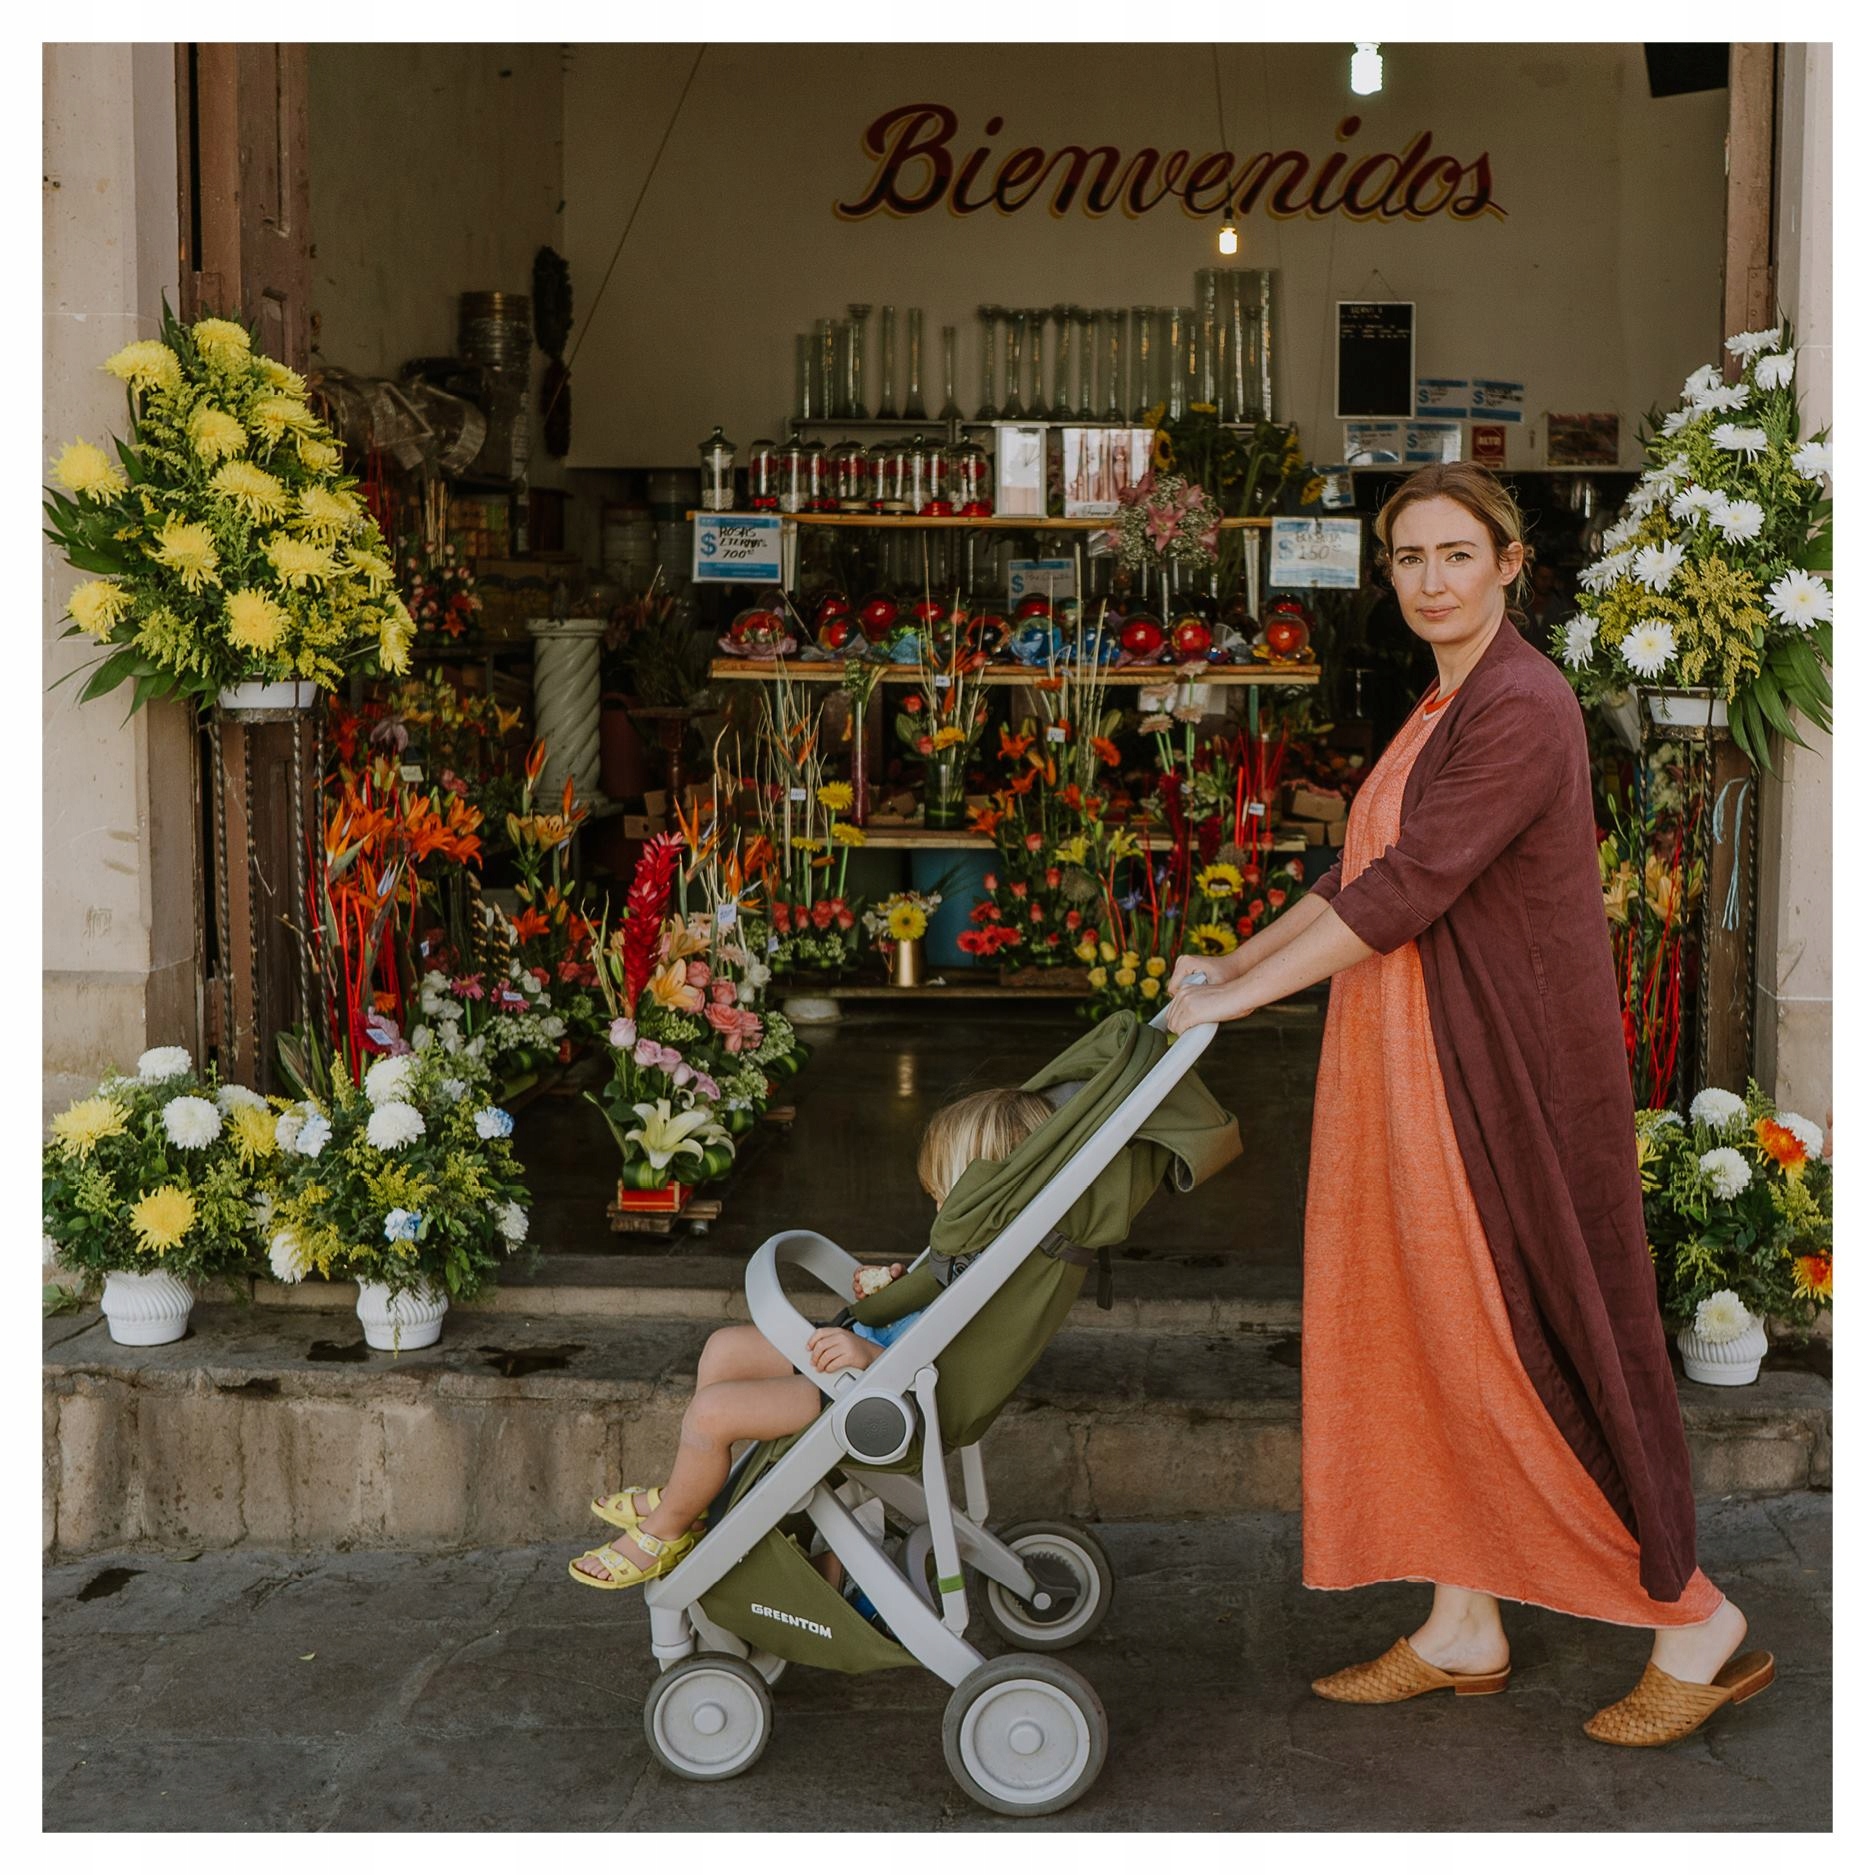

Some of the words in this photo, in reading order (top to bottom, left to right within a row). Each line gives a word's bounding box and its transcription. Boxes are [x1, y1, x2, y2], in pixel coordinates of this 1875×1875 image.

[833, 103, 1508, 222] Bienvenidos
[700, 532, 718, 557] $
[1011, 574, 1025, 593] $
[751, 1603, 833, 1639] GREENTOM
